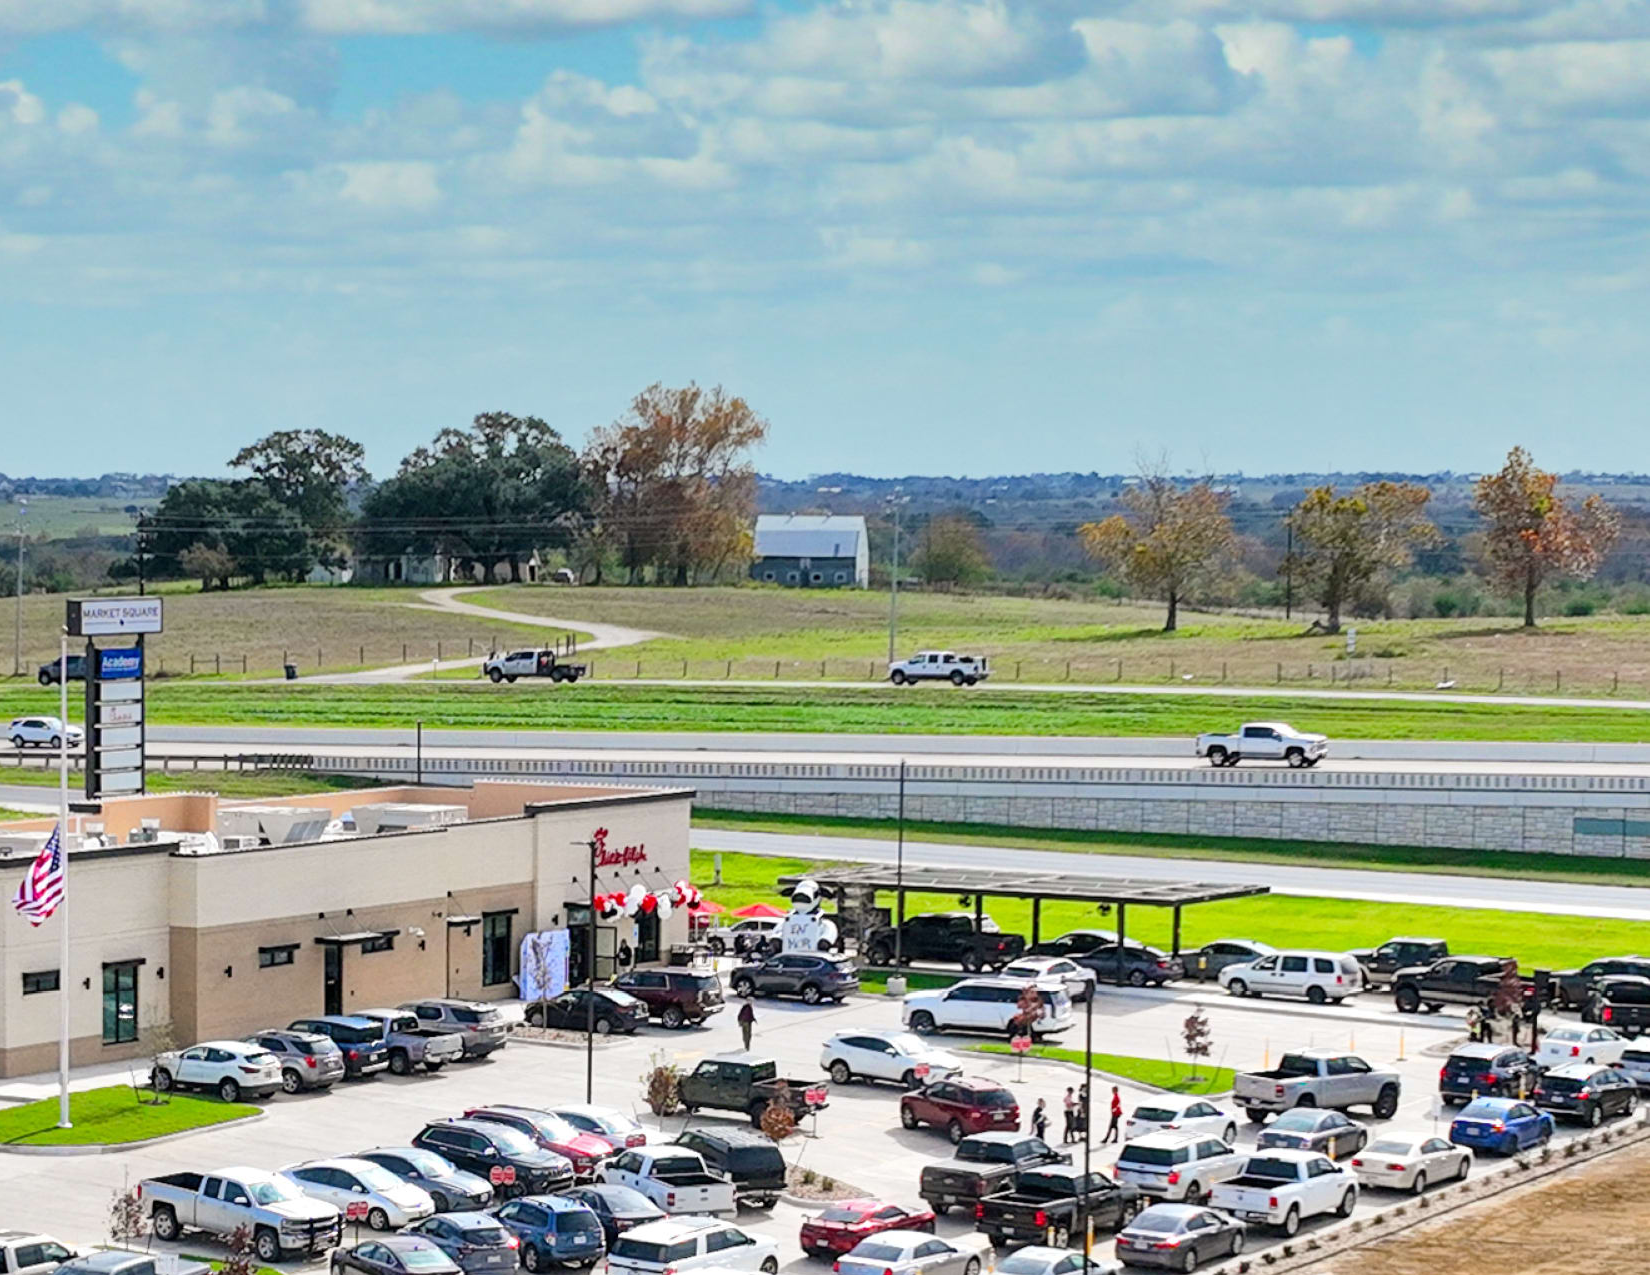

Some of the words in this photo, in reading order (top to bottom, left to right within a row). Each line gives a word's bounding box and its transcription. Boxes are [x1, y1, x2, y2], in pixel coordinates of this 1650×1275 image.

[83, 609, 121, 618] MARKET
[122, 607, 159, 617] SQUARE
[102, 656, 140, 668] Academy
